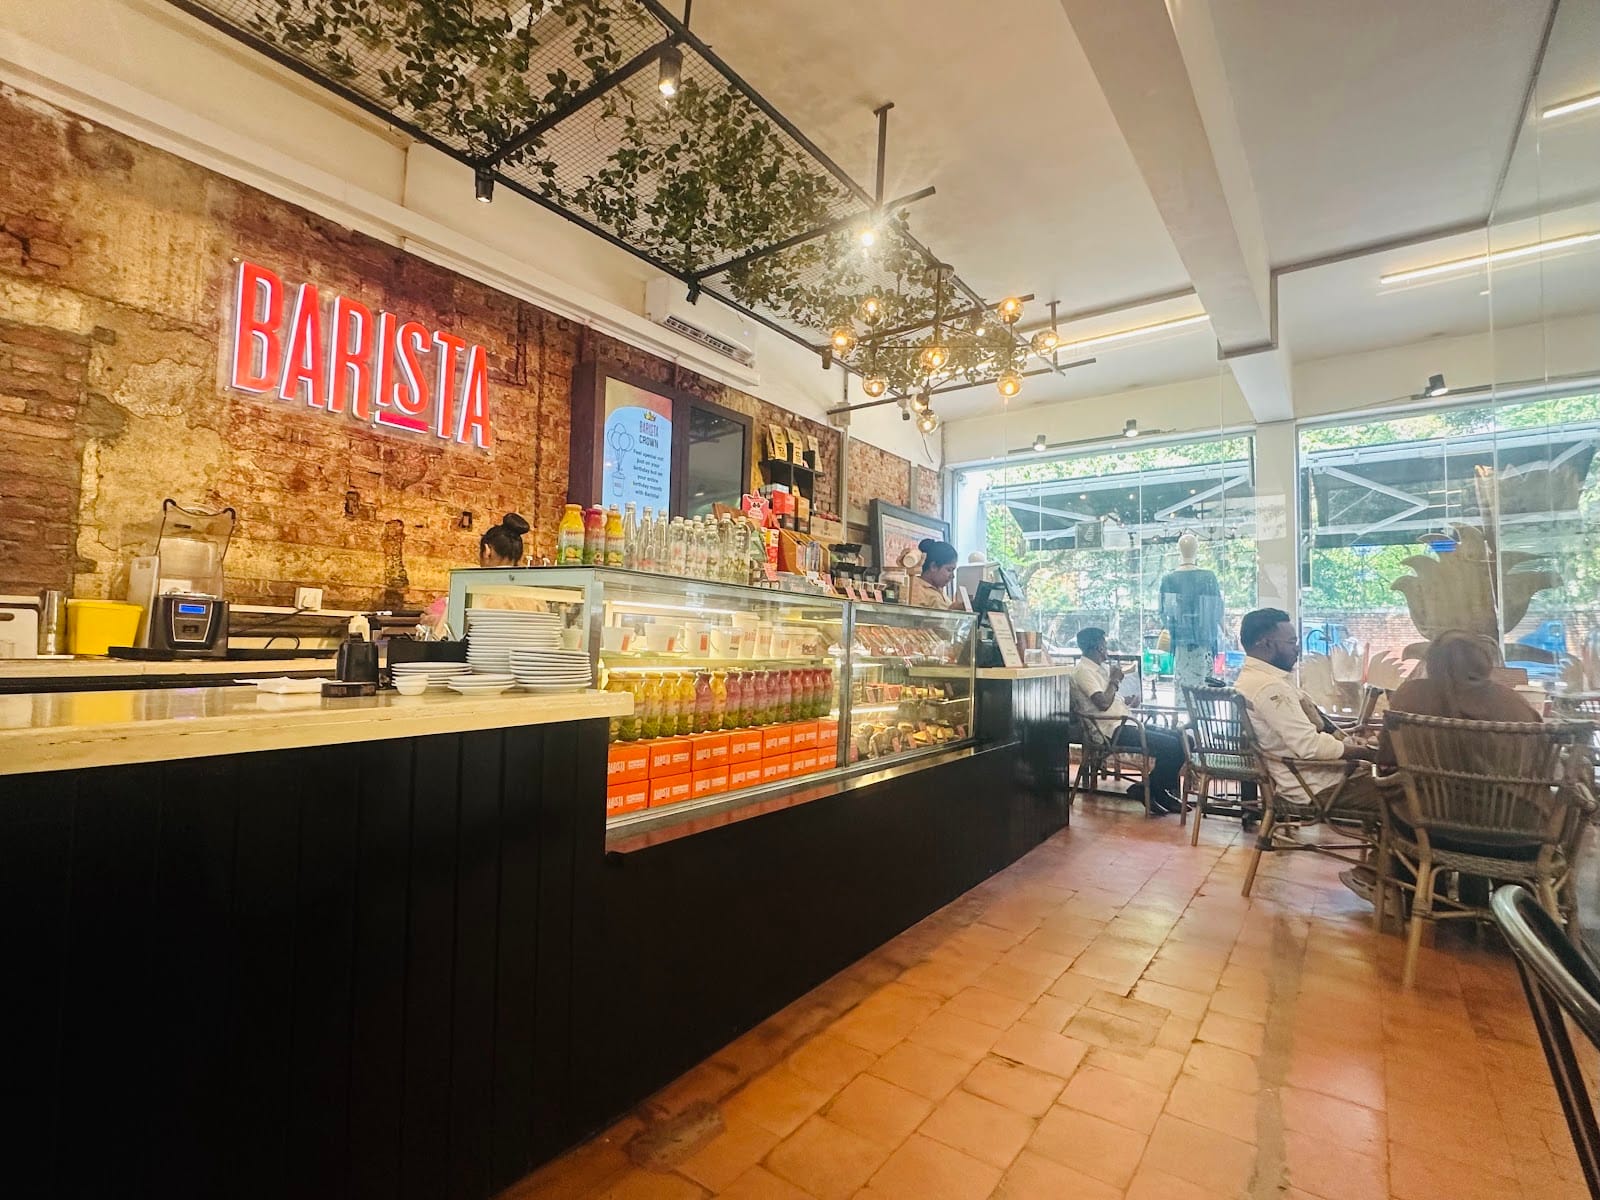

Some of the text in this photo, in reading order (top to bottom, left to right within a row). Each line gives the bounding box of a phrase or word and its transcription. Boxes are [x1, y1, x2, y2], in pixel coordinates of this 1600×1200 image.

[232, 261, 492, 449] BARISTA
[639, 420, 659, 437] BARISTA
[639, 435, 659, 449] CROWN
[633, 465, 650, 474] birthday
[632, 480, 649, 490] birthday
